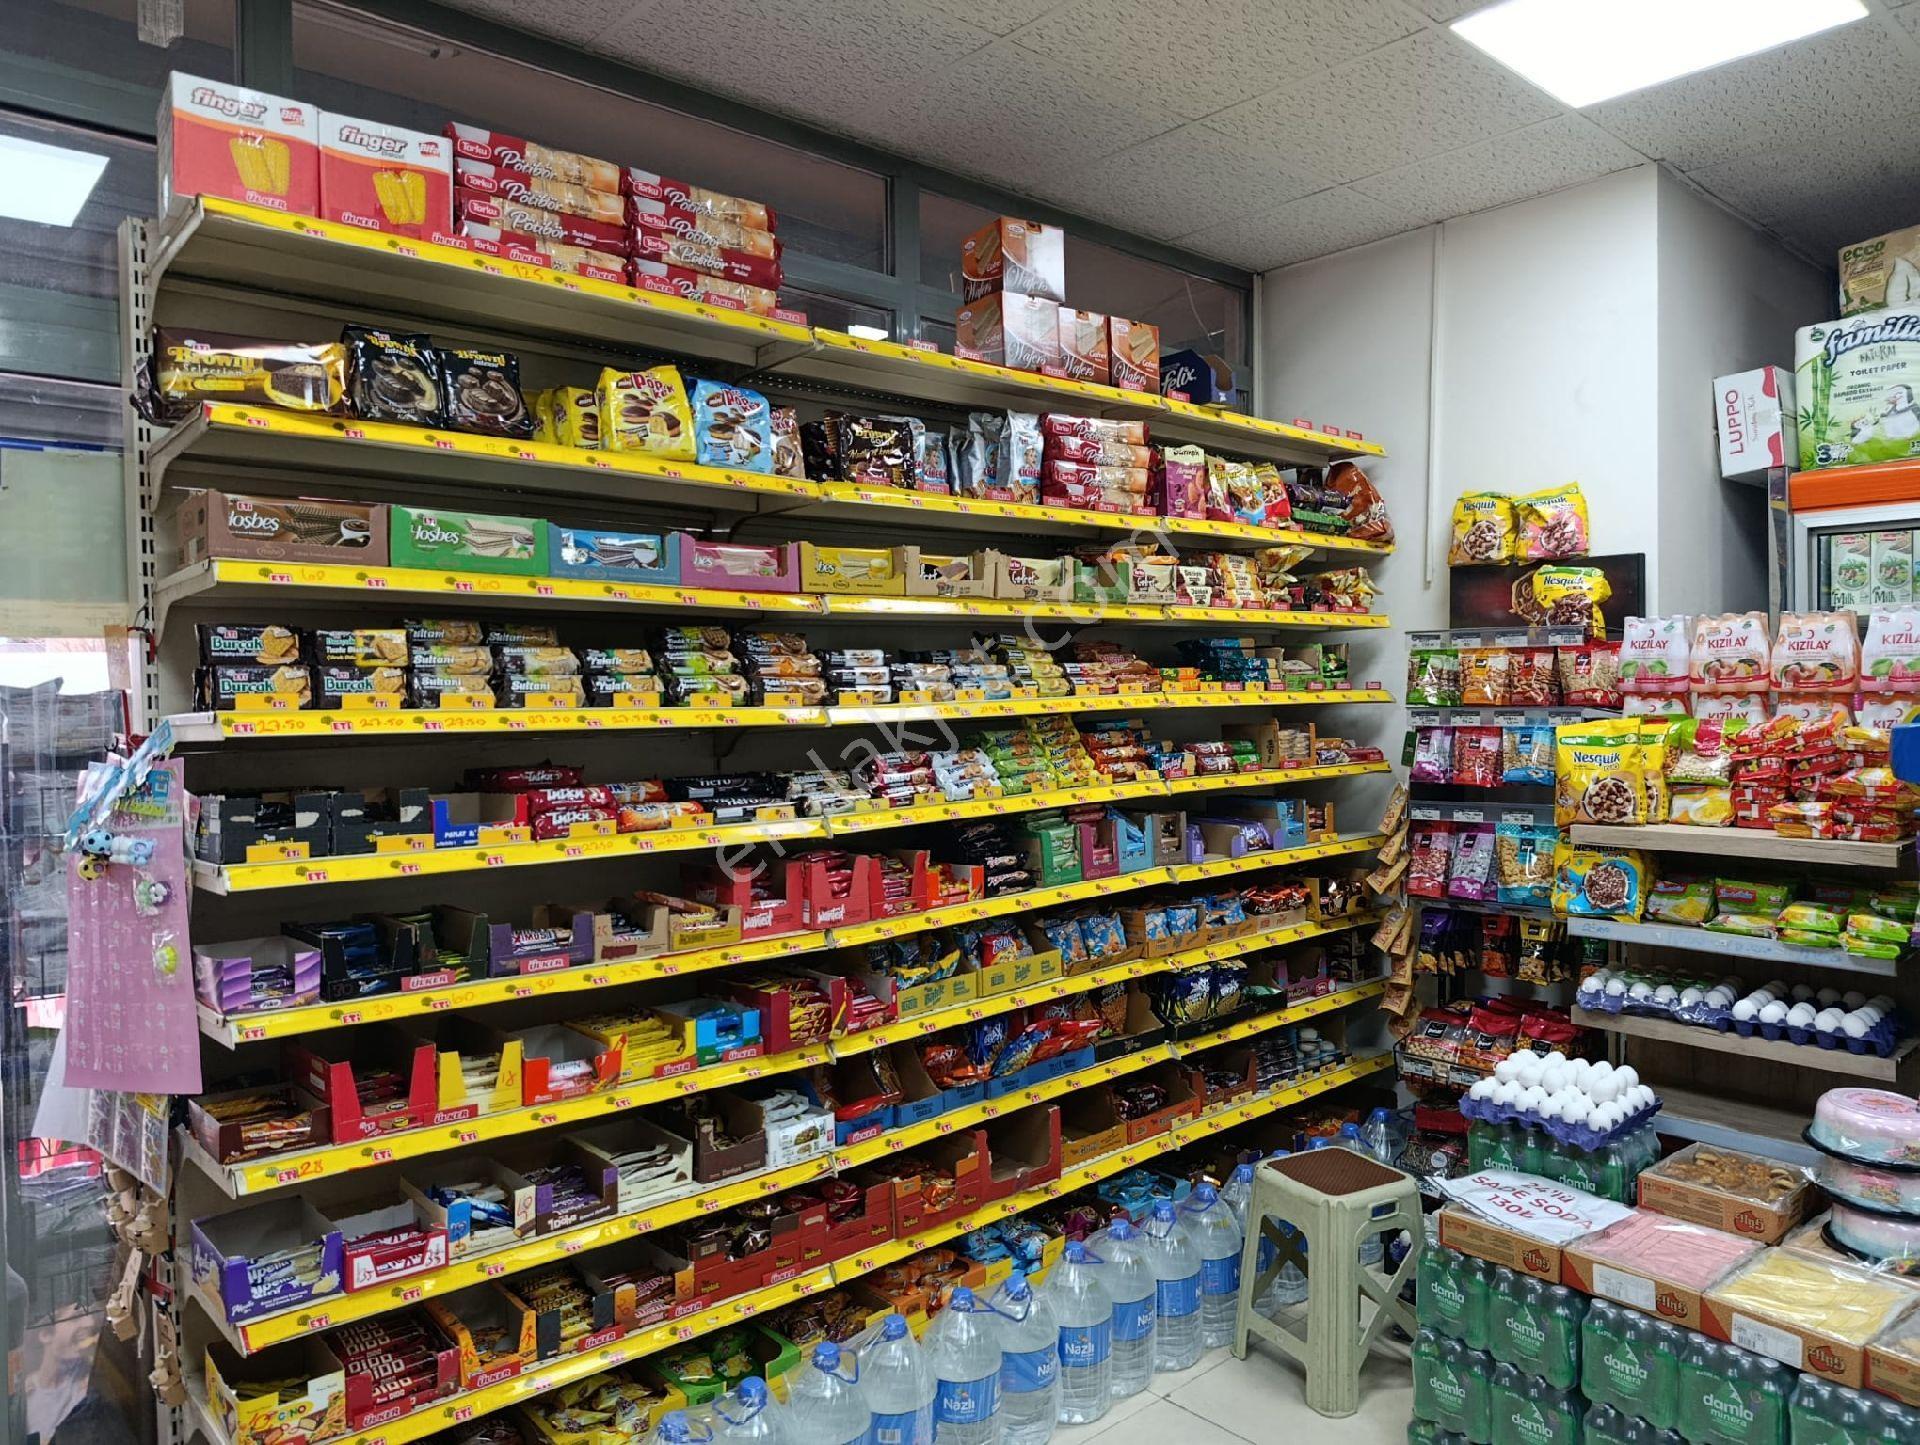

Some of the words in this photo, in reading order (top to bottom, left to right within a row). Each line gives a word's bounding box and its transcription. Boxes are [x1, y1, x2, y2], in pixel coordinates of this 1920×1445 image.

[191, 87, 267, 119] finger
[340, 125, 408, 153] finger
[463, 141, 488, 156] Torku
[497, 147, 558, 180] Pötibör
[469, 176, 493, 190] Torku
[502, 181, 563, 211] Pötibör
[473, 202, 498, 217] Torku
[510, 210, 569, 239] Pötibör
[473, 239, 499, 253] Torku
[1843, 239, 1885, 262] ecco
[509, 249, 543, 265] ÜLKER
[587, 266, 618, 282] ÜLKER
[1006, 265, 1048, 292] Wafers
[1063, 353, 1095, 378] Wafers
[1162, 366, 1196, 394] felix
[1724, 389, 1744, 455] LUPPO
[1816, 441, 1832, 464] 3
[1463, 501, 1497, 512] Nesquik
[1874, 590, 1896, 604] Milk
[211, 637, 263, 653] Burçak
[1630, 640, 1668, 651] KIZILAY
[1708, 636, 1748, 649] KIZILAY
[1788, 640, 1831, 651] KIZILAY
[1882, 633, 1920, 646] KIZILA
[413, 655, 455, 665] Sultani
[220, 678, 276, 693] Burçak
[325, 676, 373, 692] Burçak
[421, 676, 462, 688] Sultani
[511, 680, 551, 692] Sultani
[1573, 751, 1621, 766] Nesquik
[528, 958, 564, 971] ÜLKER
[409, 975, 449, 987] ÜLKER
[729, 1049, 757, 1060] ÜLKER
[663, 1062, 690, 1075] ÜLKER
[434, 1109, 469, 1123] ÜLKER
[298, 1160, 324, 1177] 28
[1484, 1158, 1519, 1174] damla
[1559, 1175, 1596, 1192] damla
[1472, 1175, 1531, 1201] SADE
[1529, 1198, 1594, 1230] SODA
[1431, 1281, 1465, 1303] damla
[675, 1301, 702, 1316] ÜLKER
[1506, 1317, 1545, 1341] damla
[585, 1331, 616, 1348] ÜLKER
[1065, 1342, 1094, 1356] Nazlı
[1603, 1354, 1648, 1380] damla
[1609, 1368, 1642, 1386] minera
[1430, 1378, 1466, 1398] damla
[943, 1396, 975, 1412] Nazlı
[1703, 1394, 1754, 1422] damla
[363, 1407, 400, 1426] ÜLKER
[1710, 1407, 1748, 1427] minera
[1511, 1414, 1553, 1438] damla
